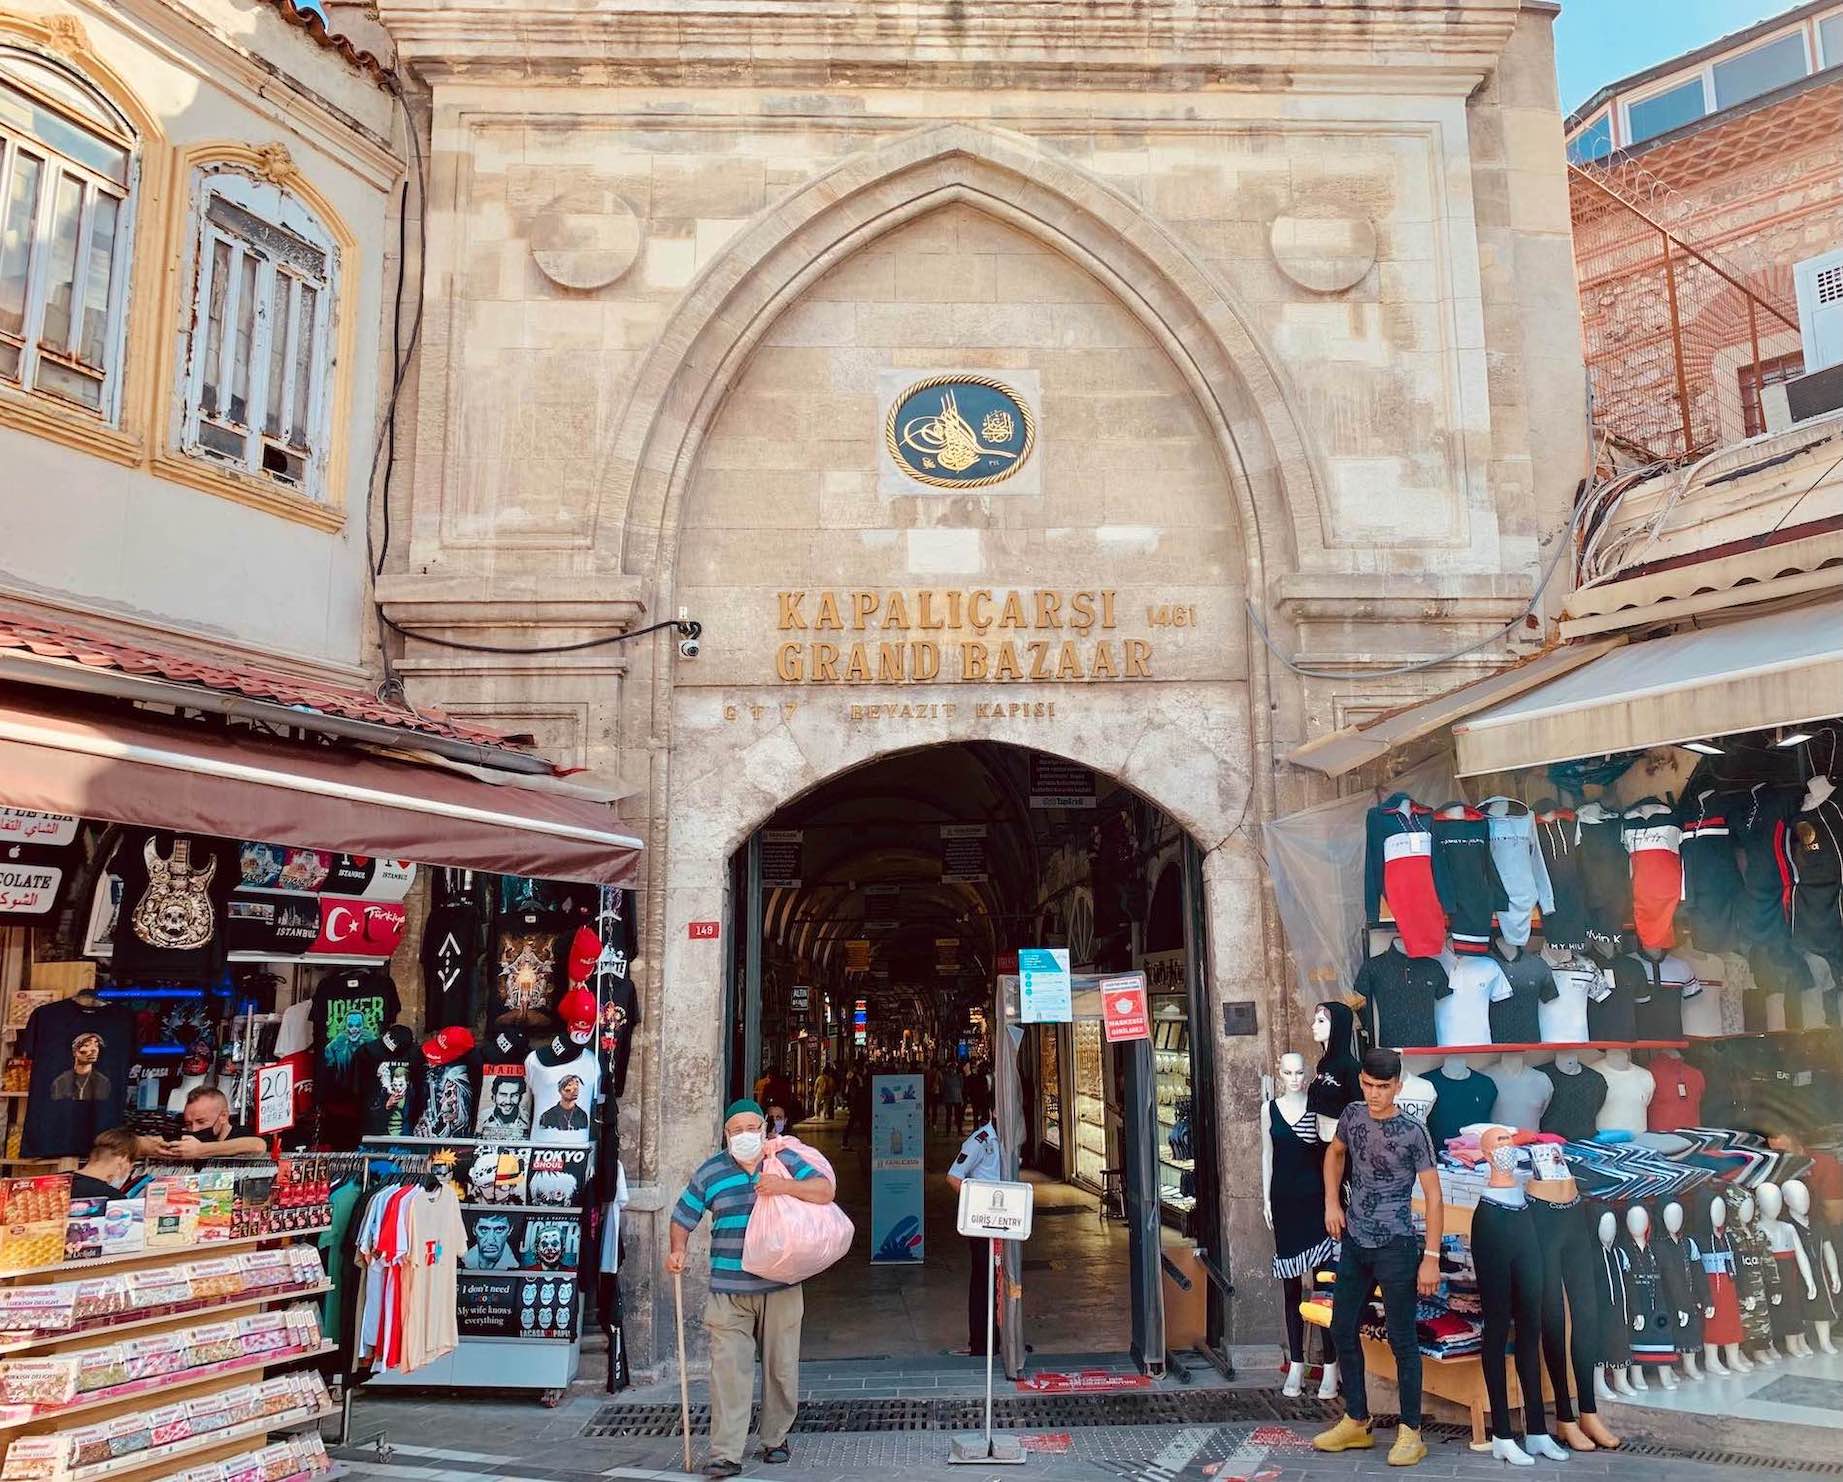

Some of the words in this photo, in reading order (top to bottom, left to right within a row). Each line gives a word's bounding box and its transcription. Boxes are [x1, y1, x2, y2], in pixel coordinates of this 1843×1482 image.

[778, 591, 1117, 637] KAPALIÇARŞI
[1146, 604, 1197, 629] 1461
[777, 641, 941, 682] GRAND
[961, 639, 1153, 680] BAZAAR
[850, 703, 957, 720] BEYAZIT
[974, 701, 1056, 719] KAPISI
[276, 927, 317, 940] ISTANBUL
[534, 1150, 585, 1164] TOKYO
[532, 1162, 564, 1170] GHOUL
[998, 1216, 1023, 1227] ENTRY
[468, 1284, 489, 1294] don't
[490, 1285, 510, 1294] need
[470, 1305, 487, 1315] wife
[464, 1316, 504, 1327] everything
